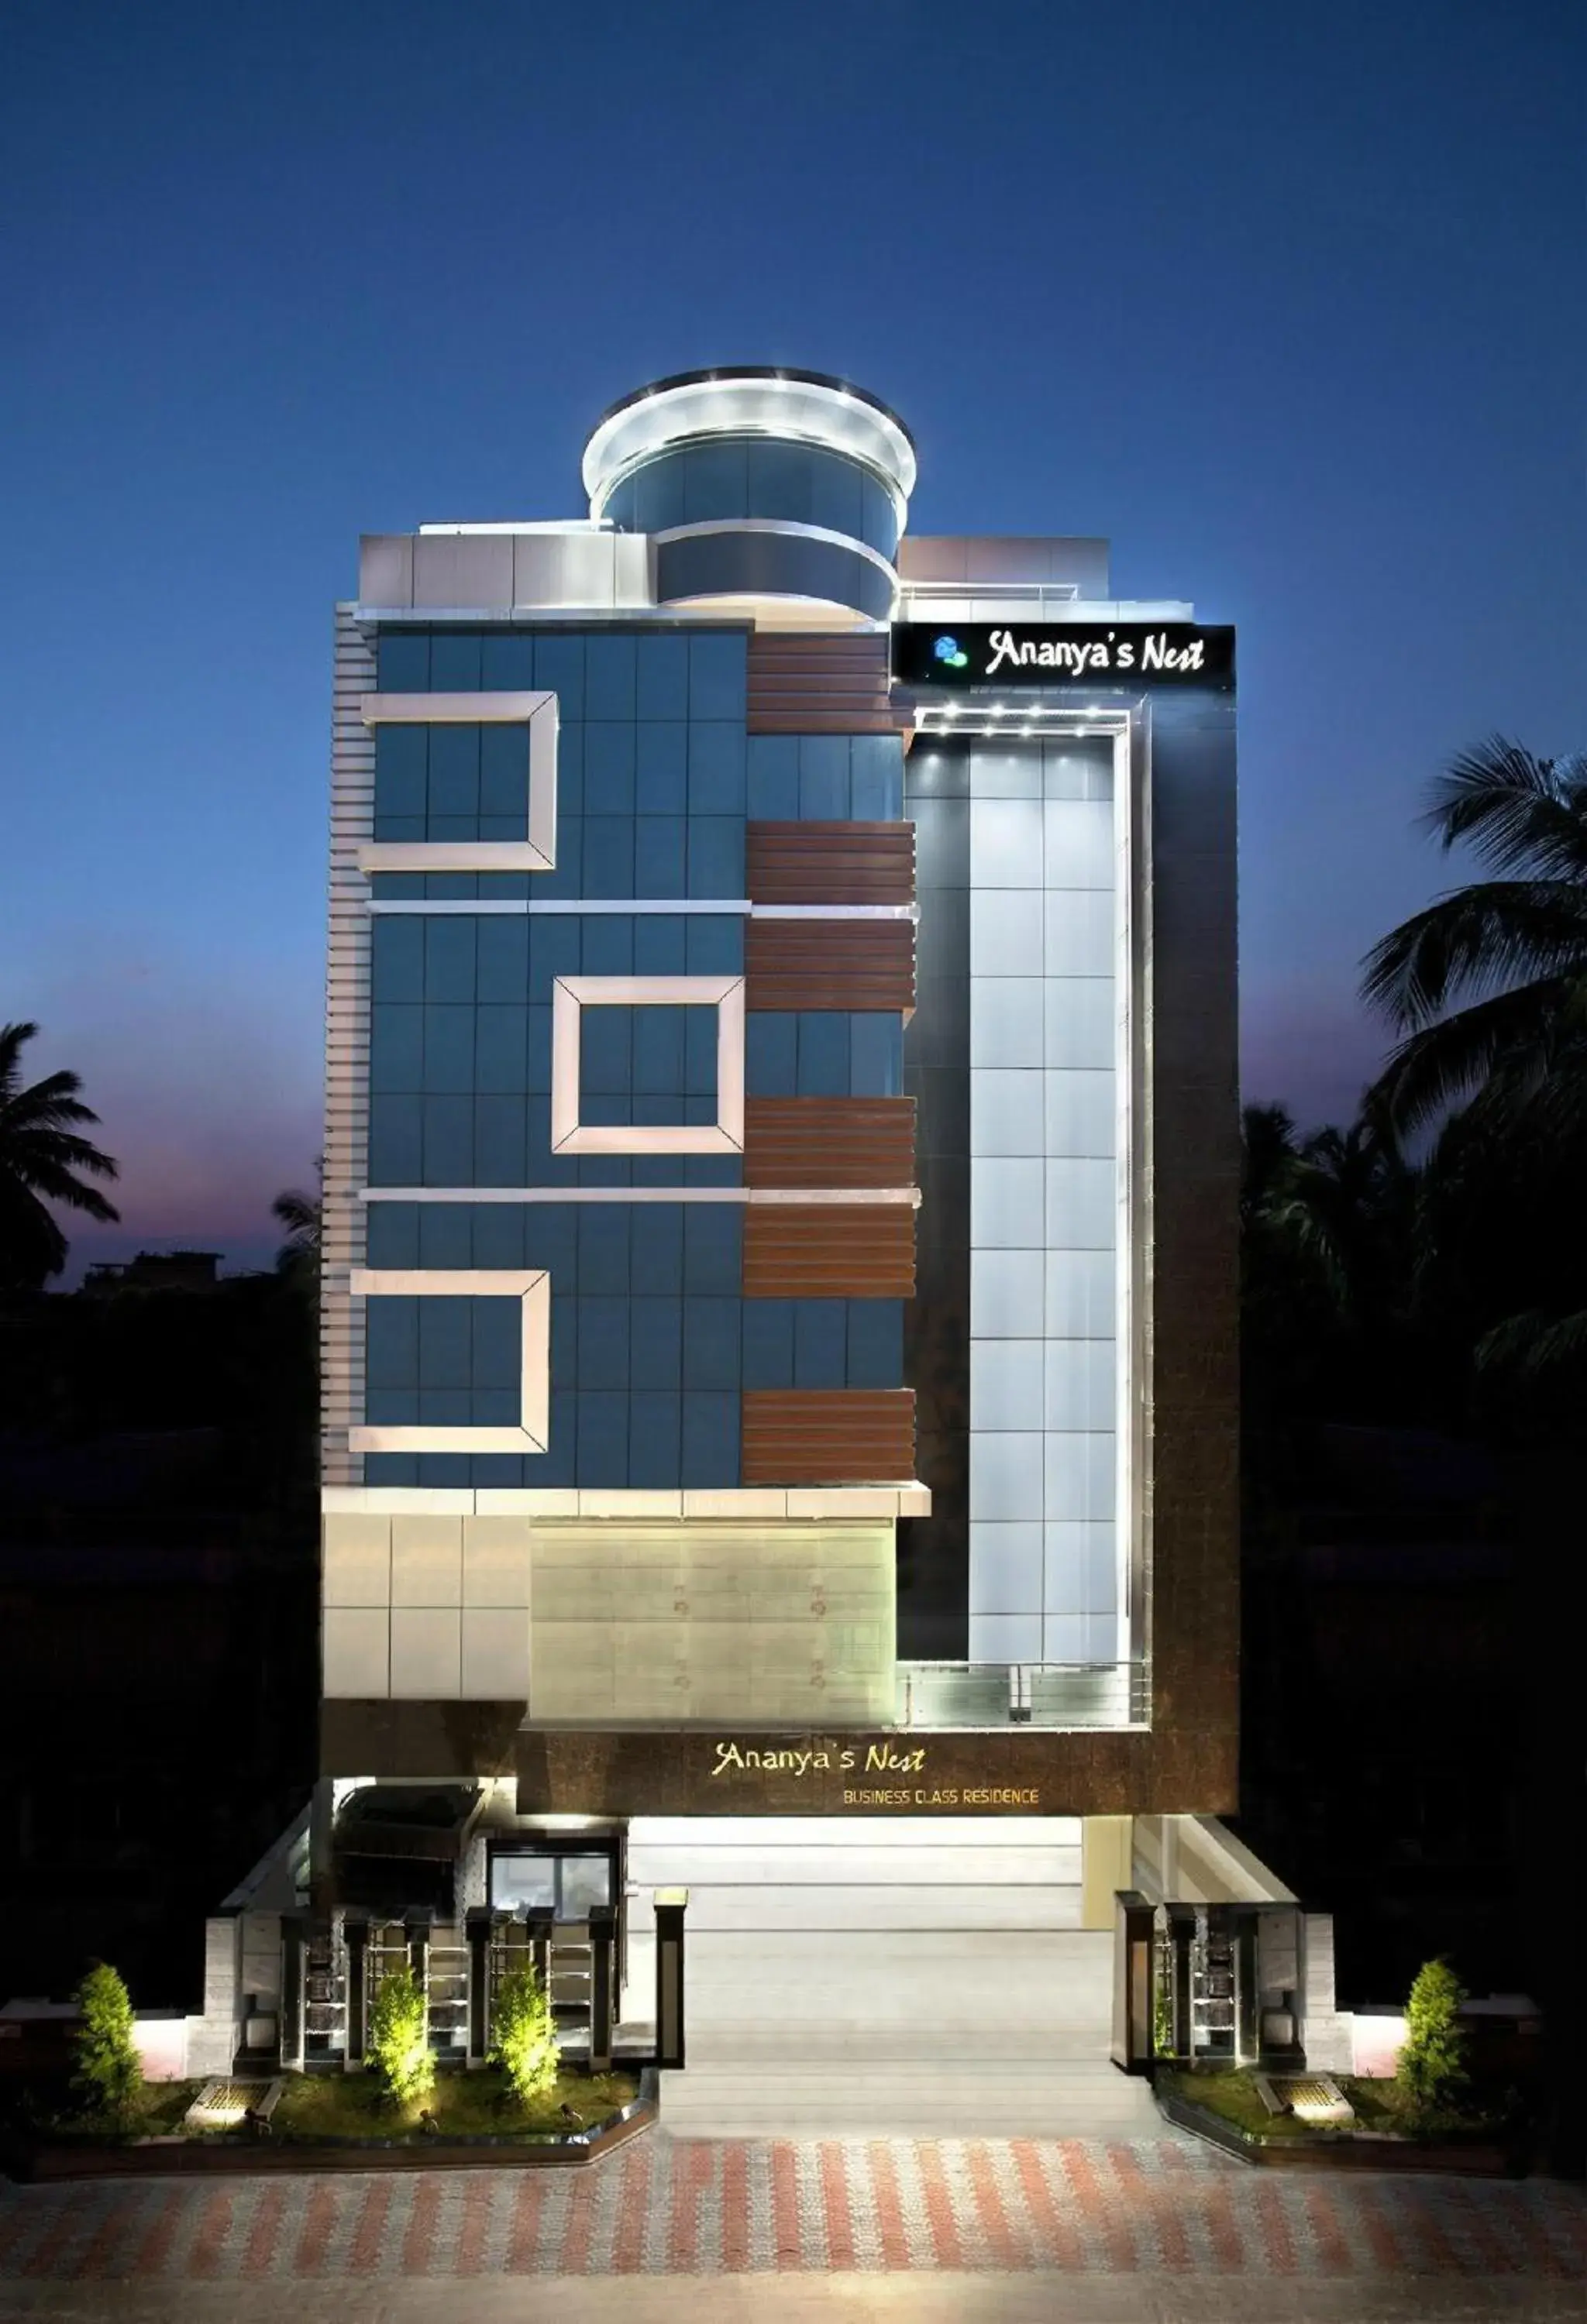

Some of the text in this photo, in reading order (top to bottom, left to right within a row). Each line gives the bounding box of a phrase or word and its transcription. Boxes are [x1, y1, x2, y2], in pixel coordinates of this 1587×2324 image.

[985, 630, 1205, 676] Ananya's Nest
[711, 1741, 927, 1776] Ananya's Nest
[843, 1789, 1040, 1805] BUSINESS CLASS RESIDENCE
